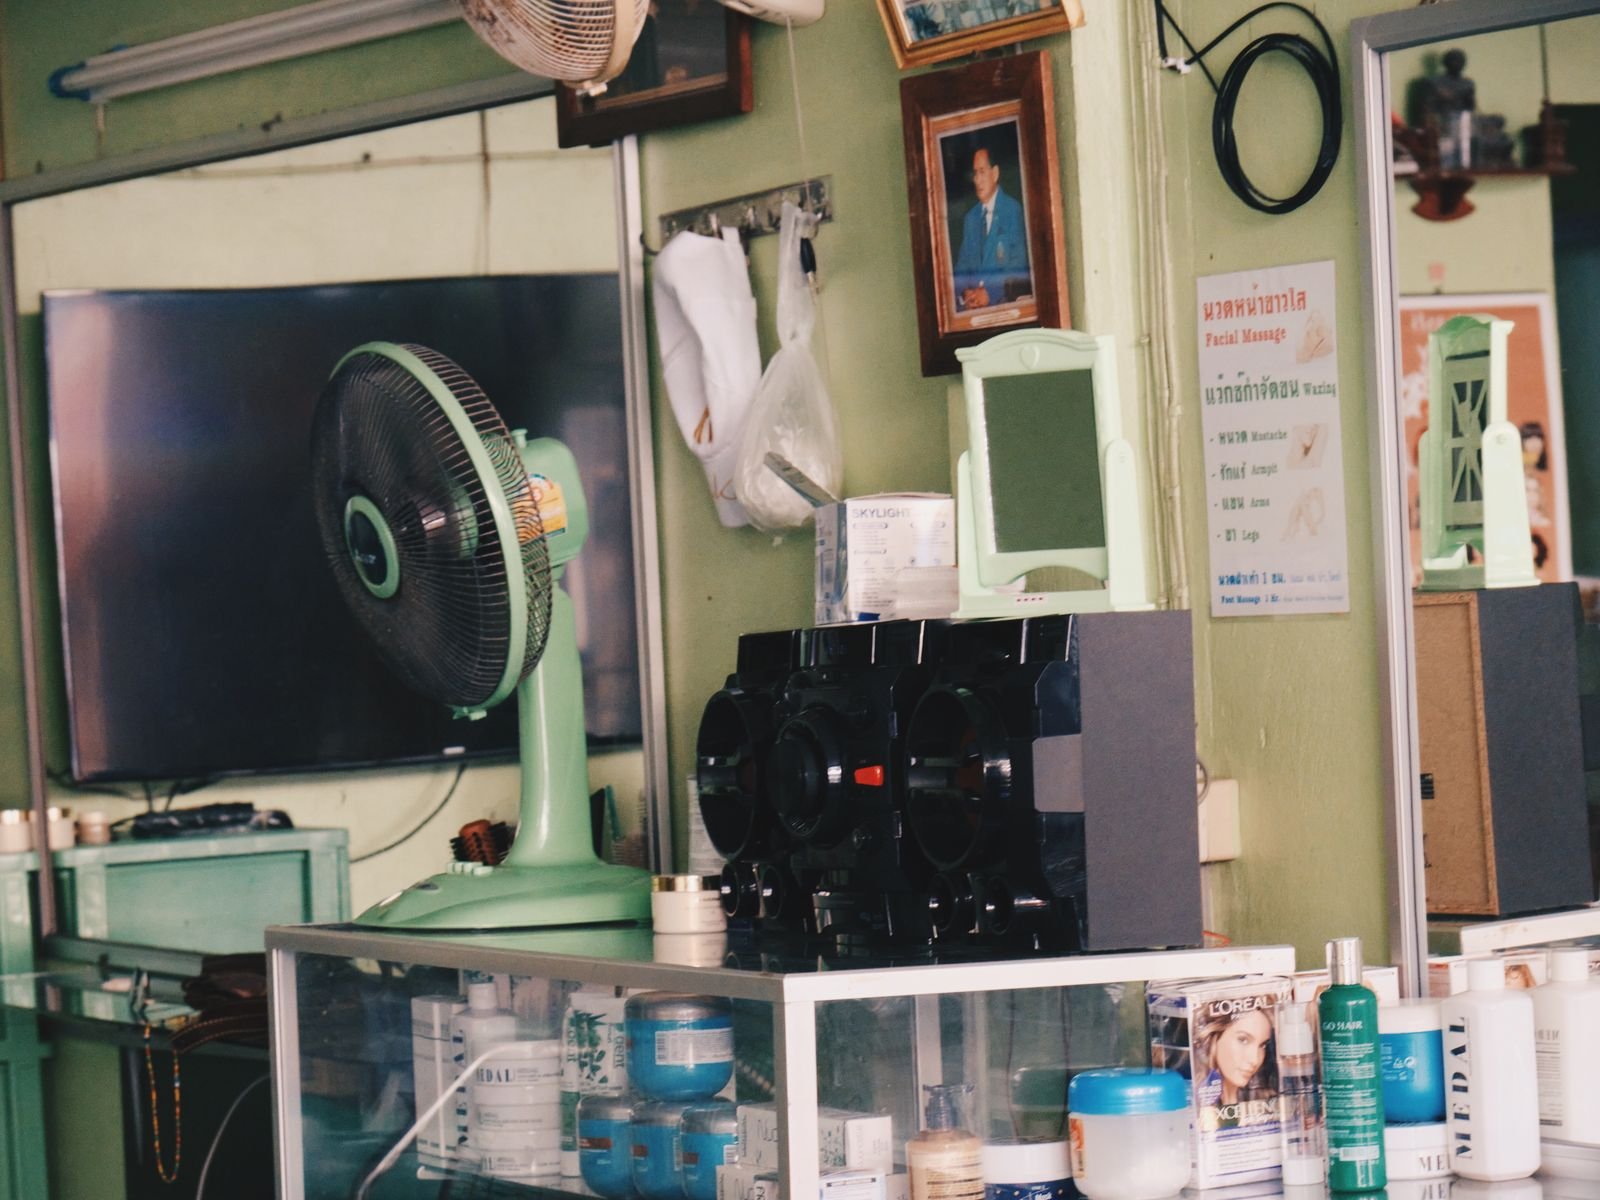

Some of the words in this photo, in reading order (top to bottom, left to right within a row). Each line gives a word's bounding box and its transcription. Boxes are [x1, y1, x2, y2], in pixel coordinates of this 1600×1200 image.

[1205, 330, 1238, 347] Facial
[1242, 327, 1286, 344] Massage
[1303, 381, 1336, 398] Waxing
[852, 507, 912, 519] SKYLIGHT
[1208, 995, 1273, 1018] L'ORÉAL
[1449, 1015, 1474, 1160] MEDAL
